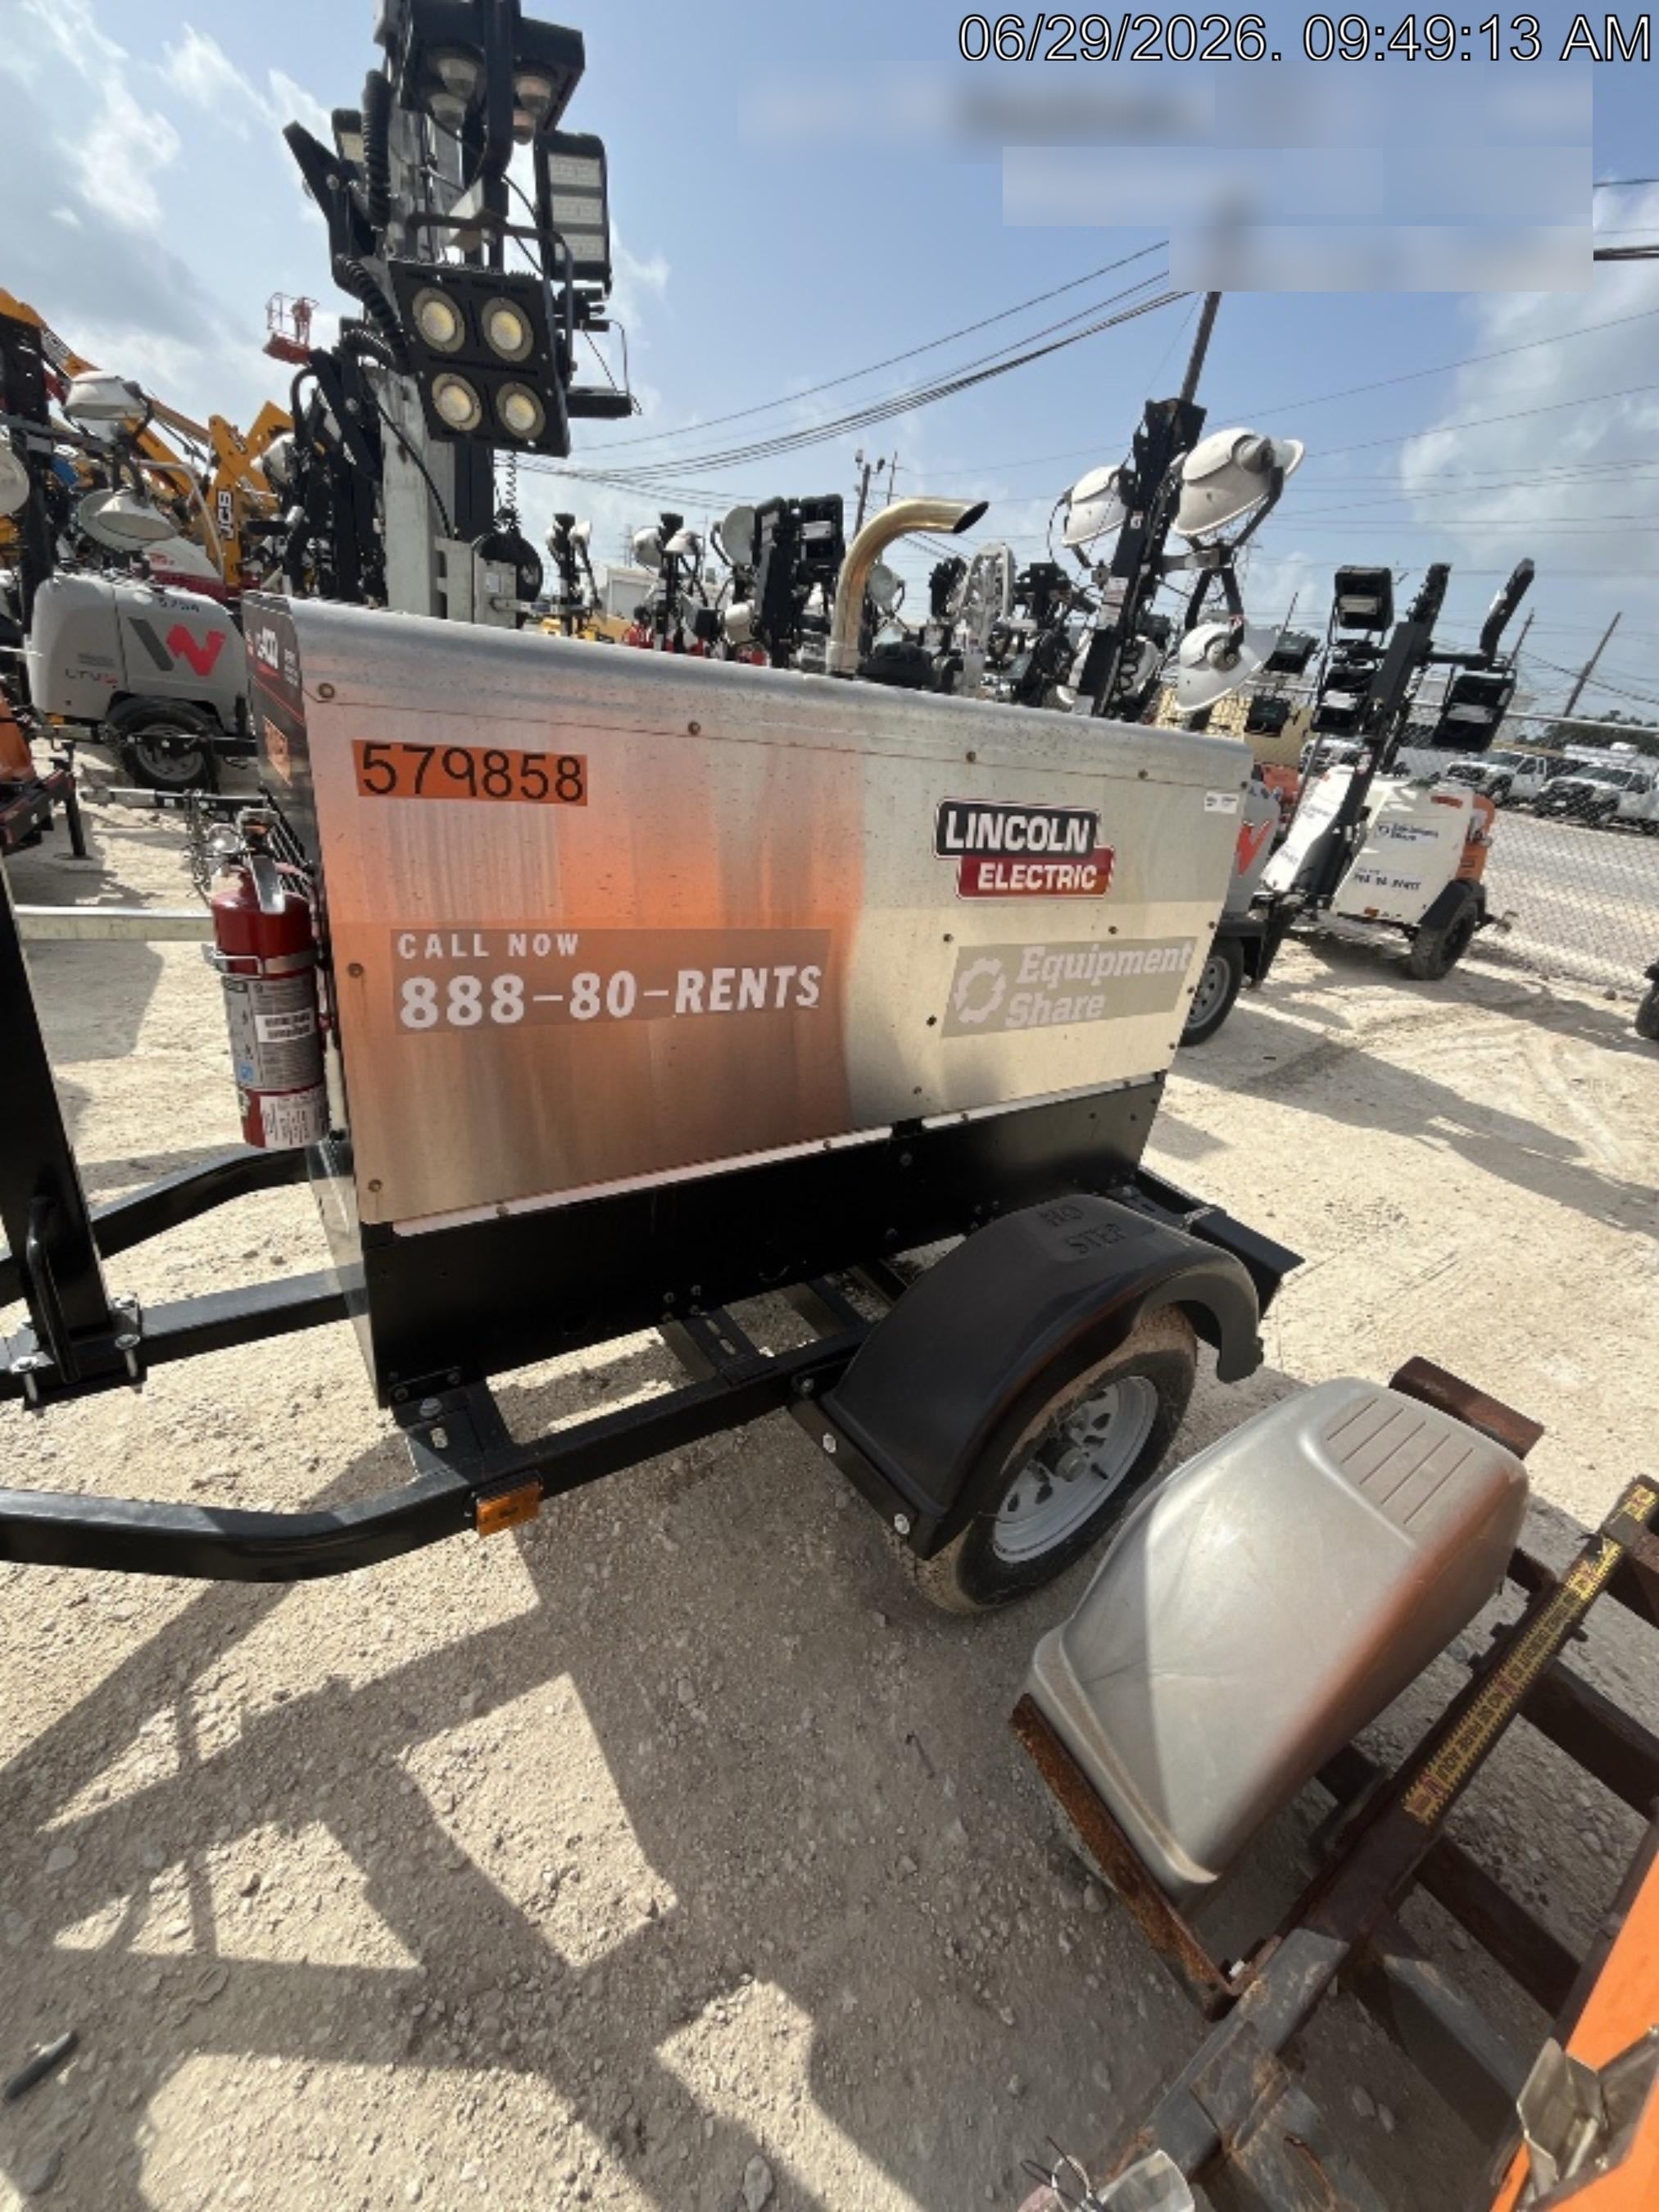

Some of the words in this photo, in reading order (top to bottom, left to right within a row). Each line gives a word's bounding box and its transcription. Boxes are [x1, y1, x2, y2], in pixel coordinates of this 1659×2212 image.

[217, 490, 234, 539] JCB
[362, 742, 583, 802] 579858
[945, 809, 1090, 854] LINCOLN
[977, 862, 1098, 891] ELECTRIC
[397, 932, 490, 959] CALL
[507, 933, 579, 958] NOW
[1015, 942, 1195, 988] Equipment
[399, 964, 823, 1030] 888-80-RENTS
[1005, 991, 1107, 1028] Share
